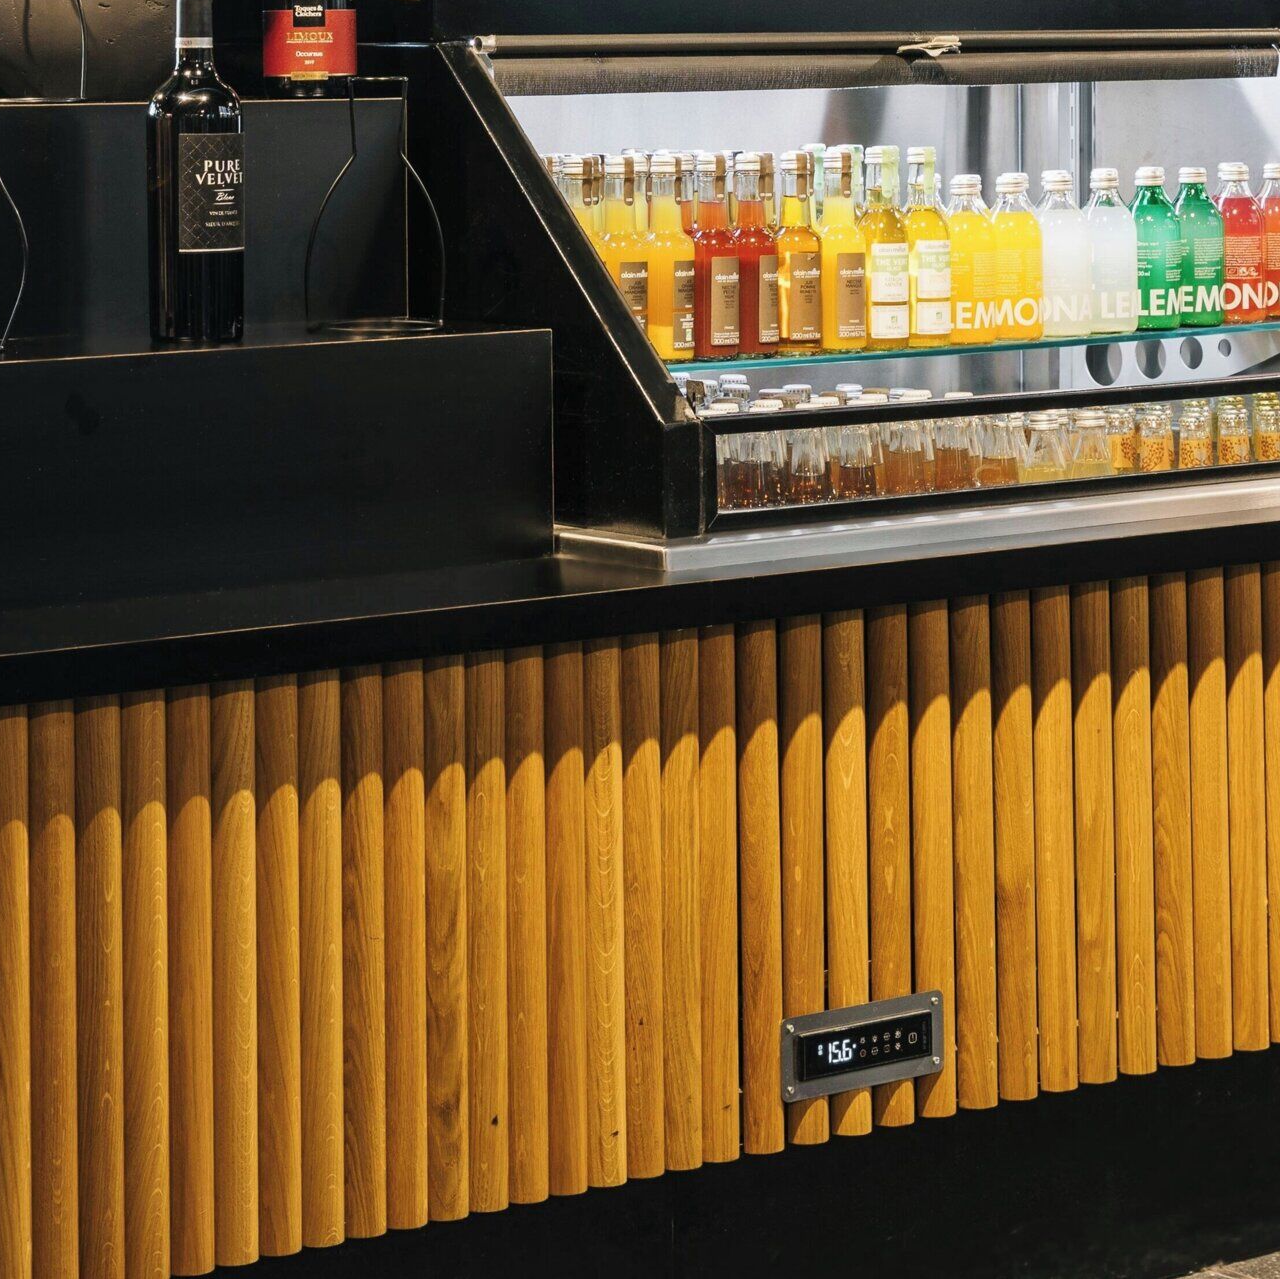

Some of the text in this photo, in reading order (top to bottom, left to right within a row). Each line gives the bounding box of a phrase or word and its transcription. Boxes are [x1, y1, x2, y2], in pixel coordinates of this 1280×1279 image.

[286, 32, 334, 41] LIMOUX
[203, 159, 241, 173] PURE
[195, 172, 243, 186] VELVET
[828, 1040, 852, 1064] 15.6
